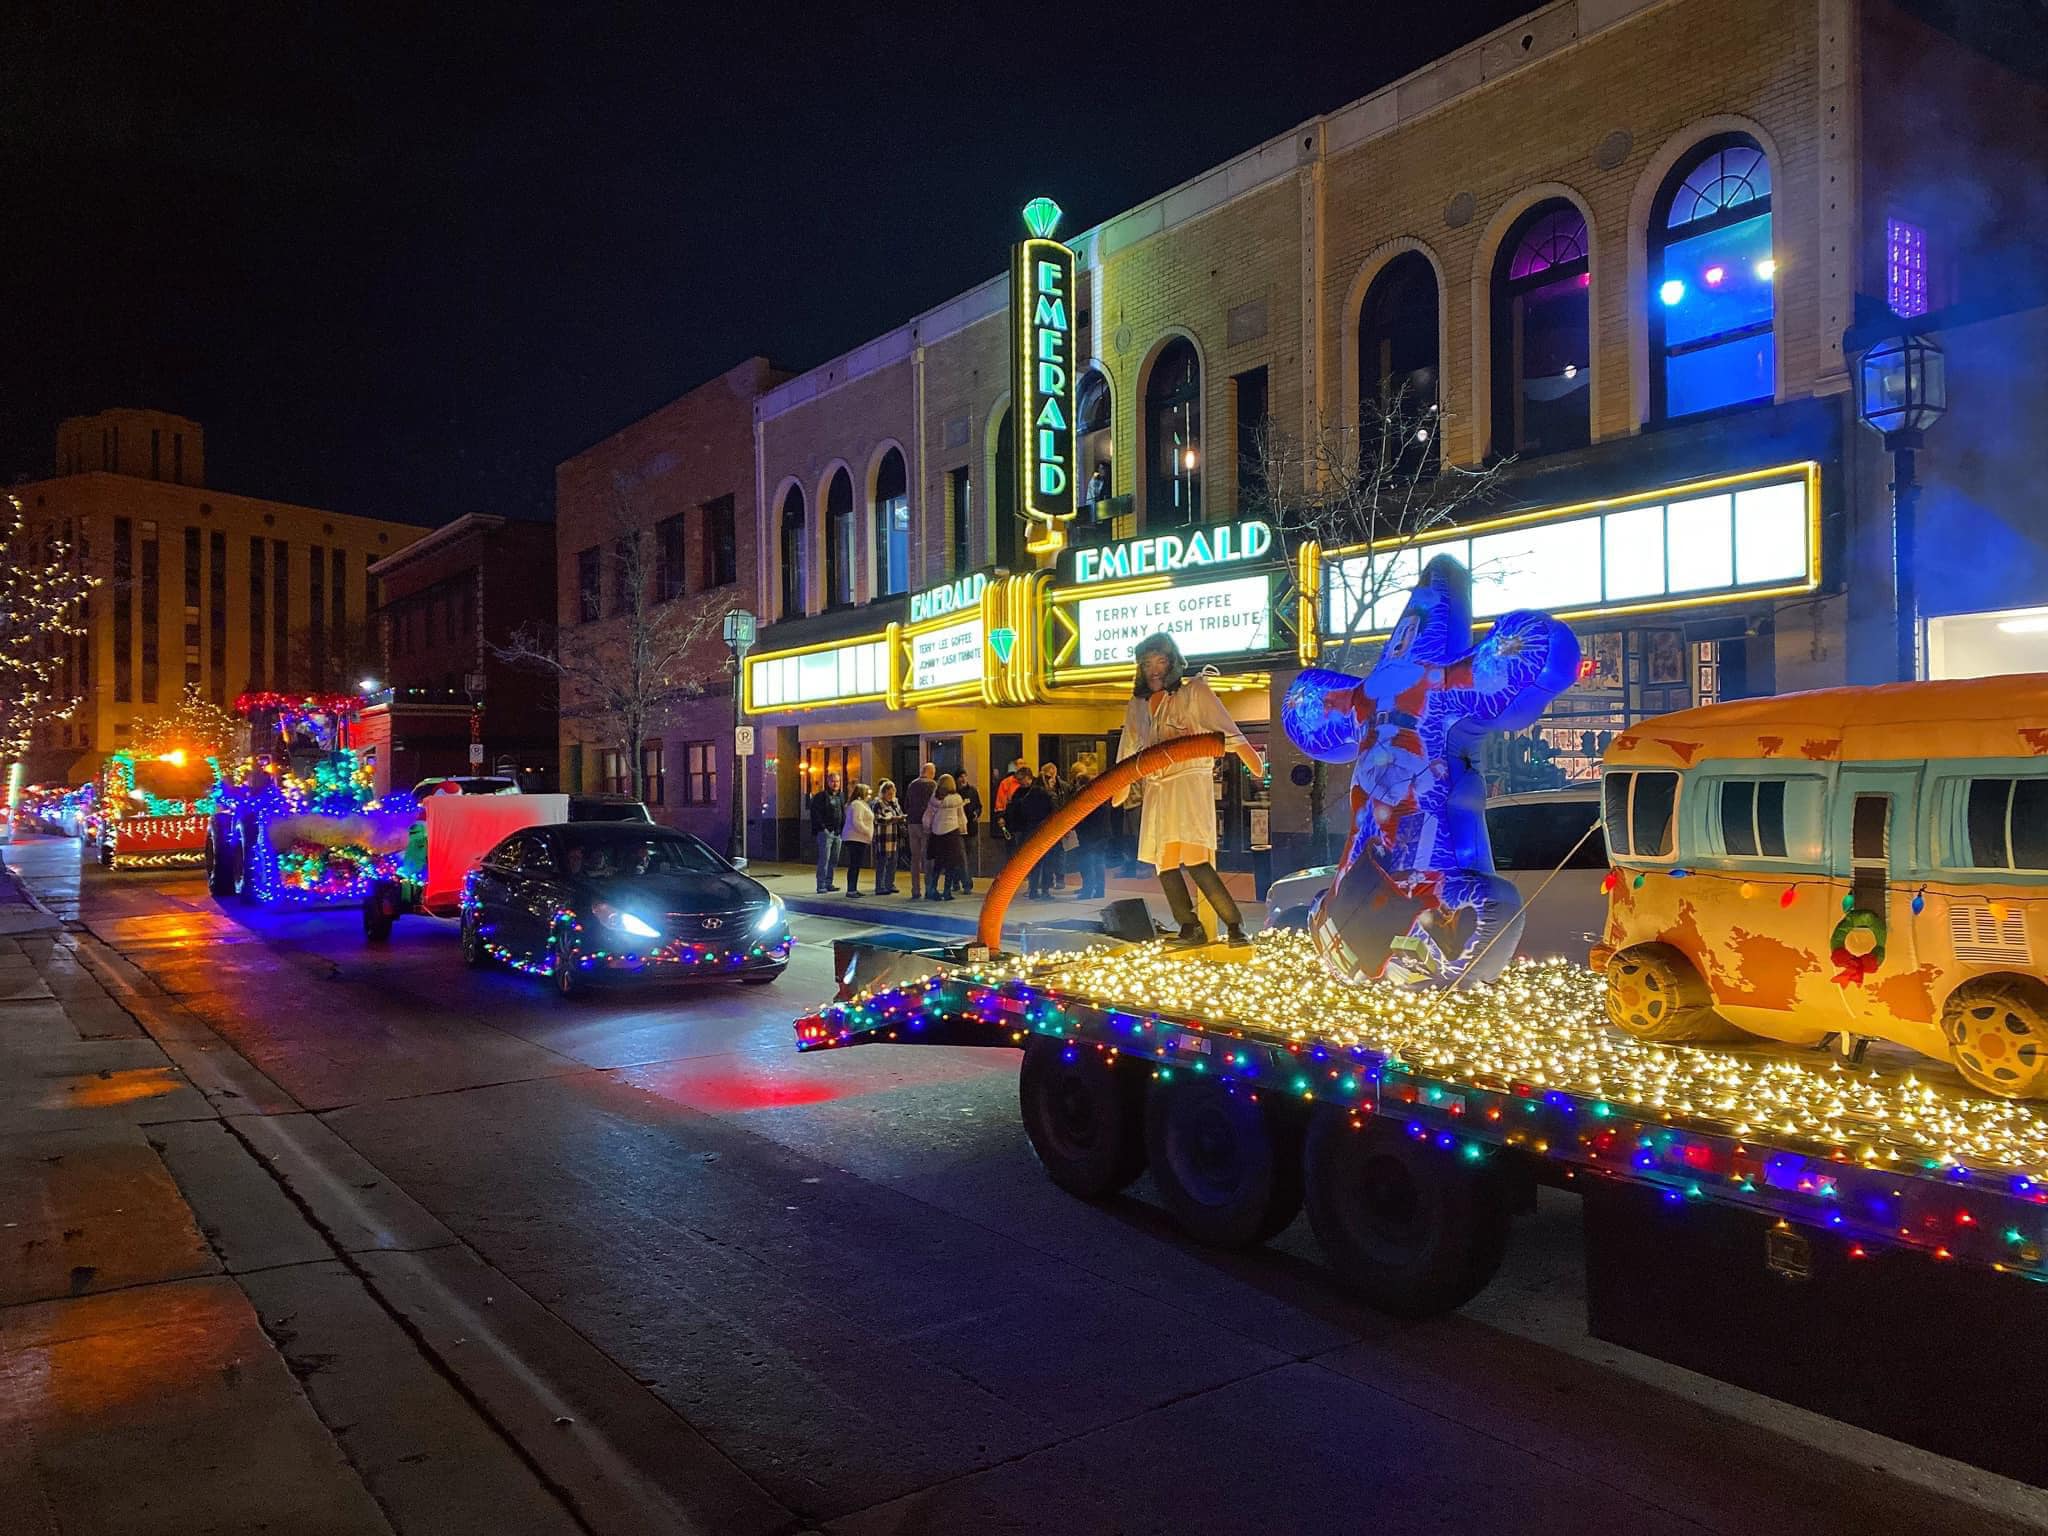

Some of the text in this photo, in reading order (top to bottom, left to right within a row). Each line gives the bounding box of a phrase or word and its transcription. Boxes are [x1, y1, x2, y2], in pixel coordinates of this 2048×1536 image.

[1034, 260, 1068, 495] EMERALD
[1075, 520, 1272, 584] EMERALD
[911, 572, 986, 623] EMERALD
[1096, 594, 1232, 622] TERRY LEE GOFFEE
[1094, 611, 1261, 641] JOHNNY CASH TRIBUTE
[1094, 647, 1117, 660] DEC
